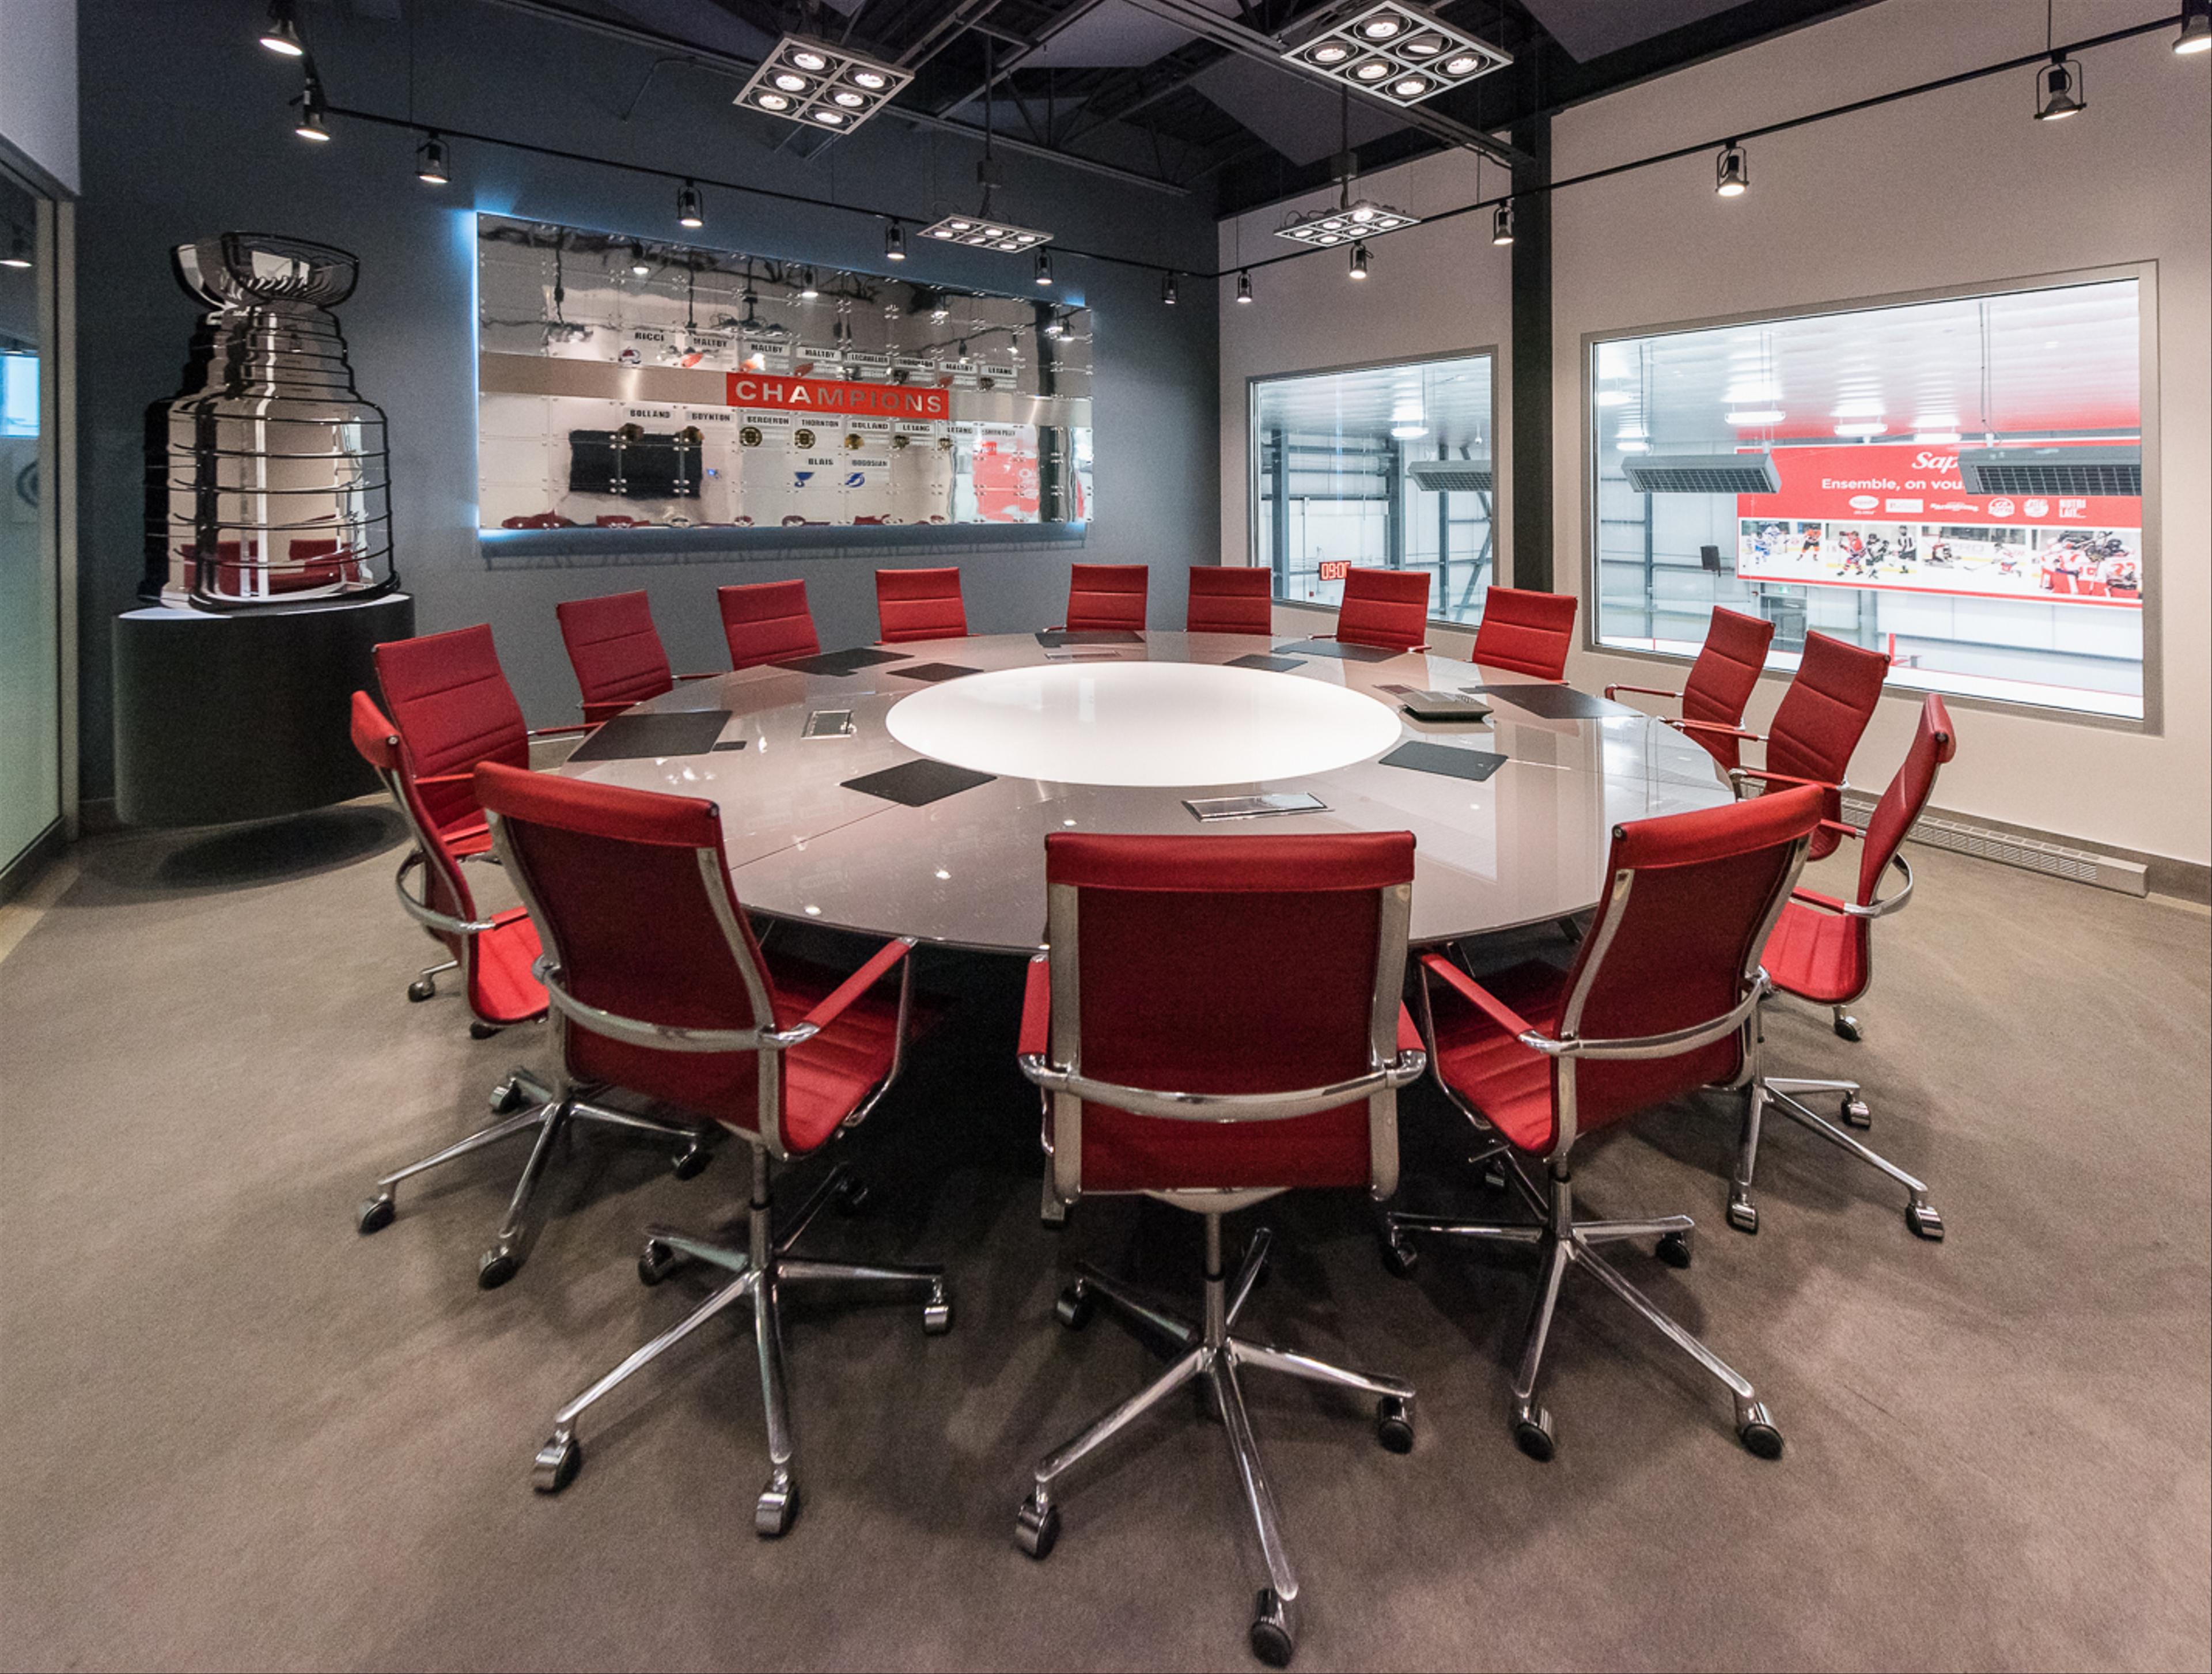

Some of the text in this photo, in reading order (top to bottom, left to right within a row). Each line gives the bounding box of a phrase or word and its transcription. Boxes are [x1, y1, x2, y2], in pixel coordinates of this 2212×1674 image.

[634, 332, 665, 342] RICCI
[693, 338, 728, 347] MALTBY
[751, 343, 783, 354] MALTBY
[805, 349, 836, 359] MALTBY
[735, 380, 942, 412] CHAMPIONS
[630, 409, 671, 419] BOLLAND
[691, 412, 731, 422] BOYNTON
[747, 415, 789, 425] BERGERON
[851, 422, 889, 430] BOLLAND
[1821, 478, 1965, 491] Ensemble, on vou
